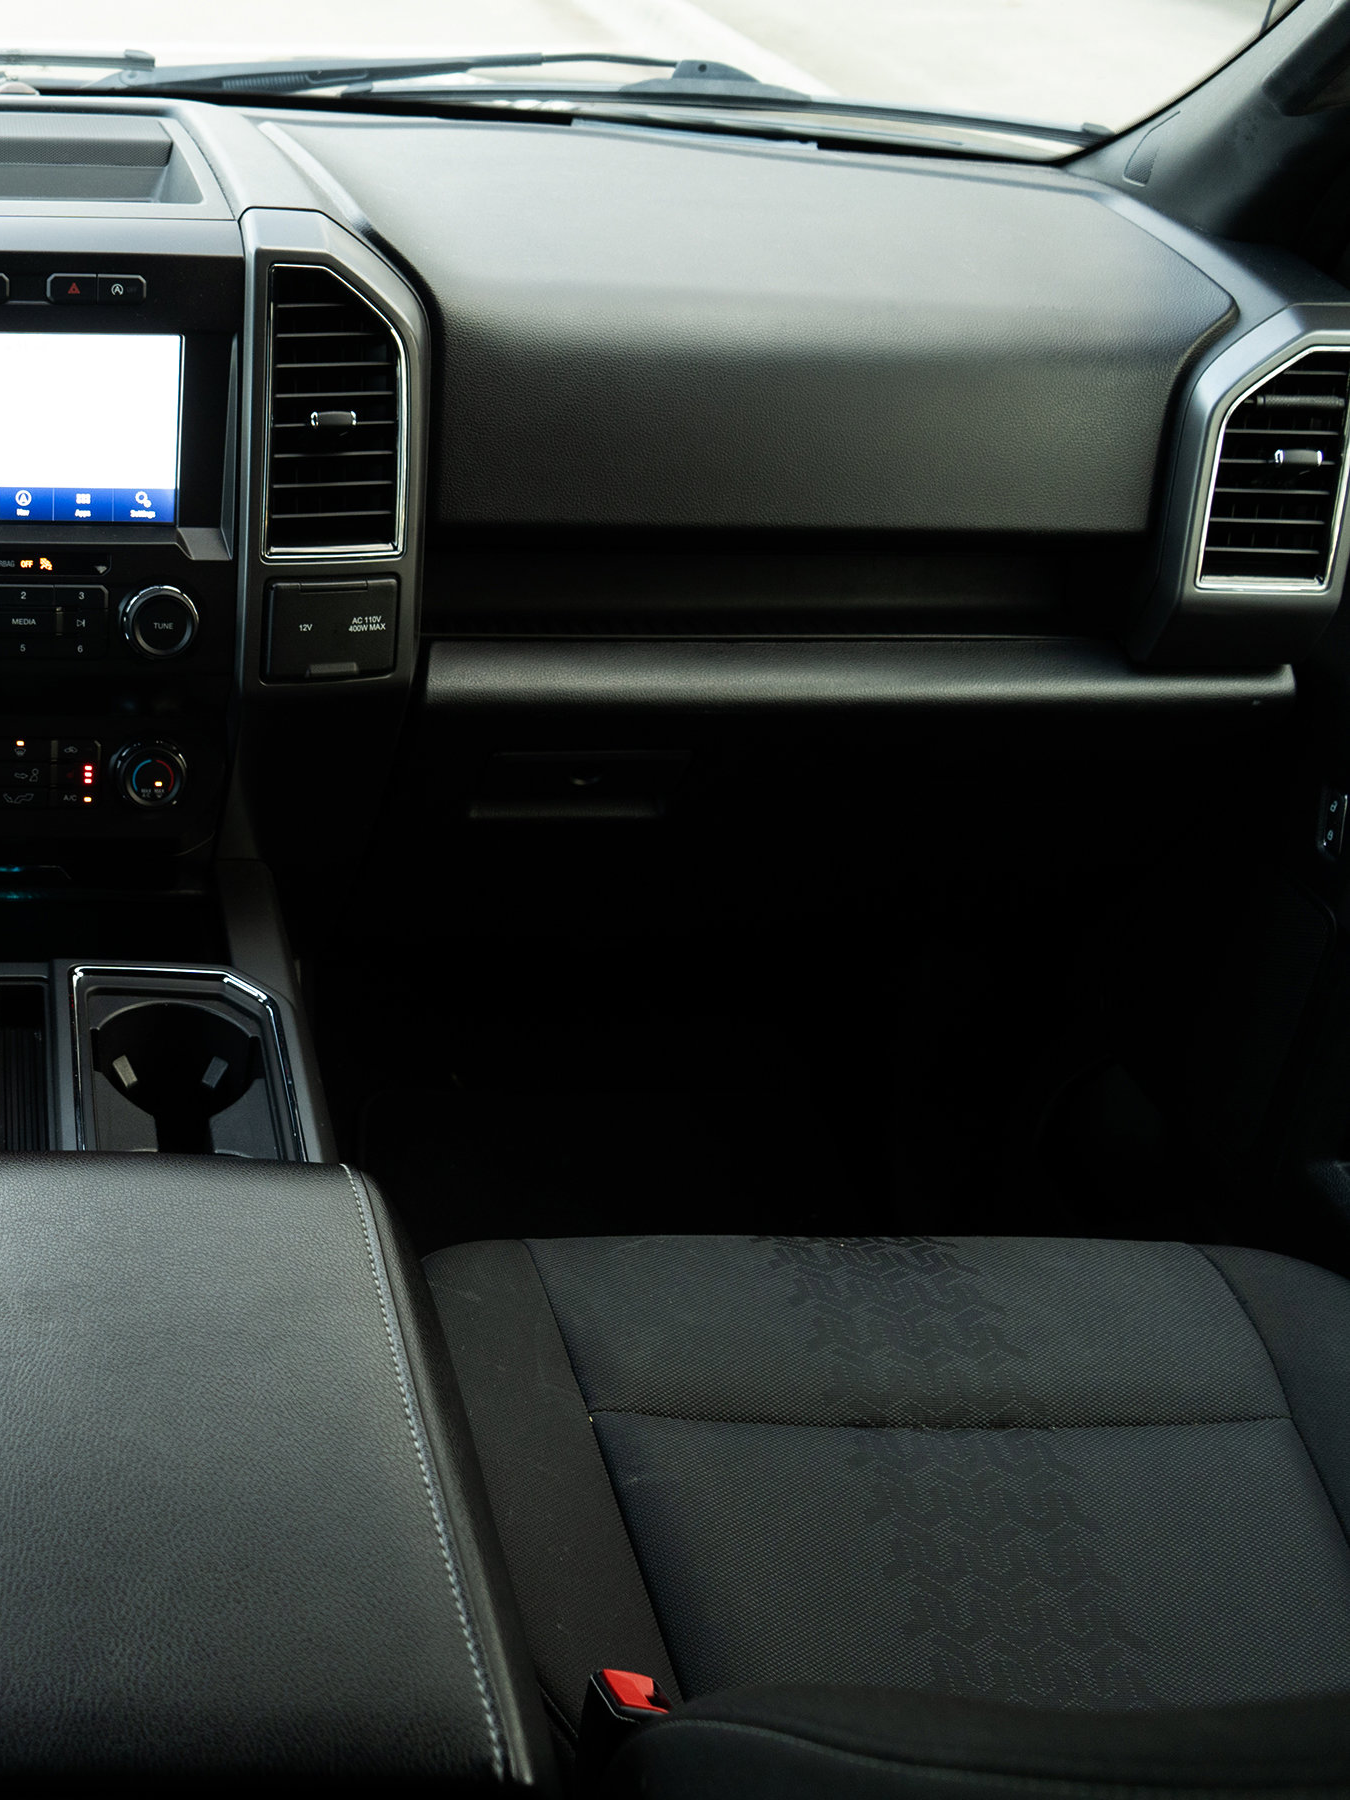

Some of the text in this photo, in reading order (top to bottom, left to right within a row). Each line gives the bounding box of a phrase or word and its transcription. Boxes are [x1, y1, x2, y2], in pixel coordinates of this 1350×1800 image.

[130, 509, 156, 519] Settings
[20, 559, 34, 568] OFF
[11, 618, 36, 626] MEDIA
[364, 616, 382, 624] 110V
[153, 623, 174, 631] TUNE
[348, 623, 386, 633] 400W MAX
[20, 644, 26, 652] 5
[77, 645, 83, 653] 6
[63, 793, 77, 801] A/C
